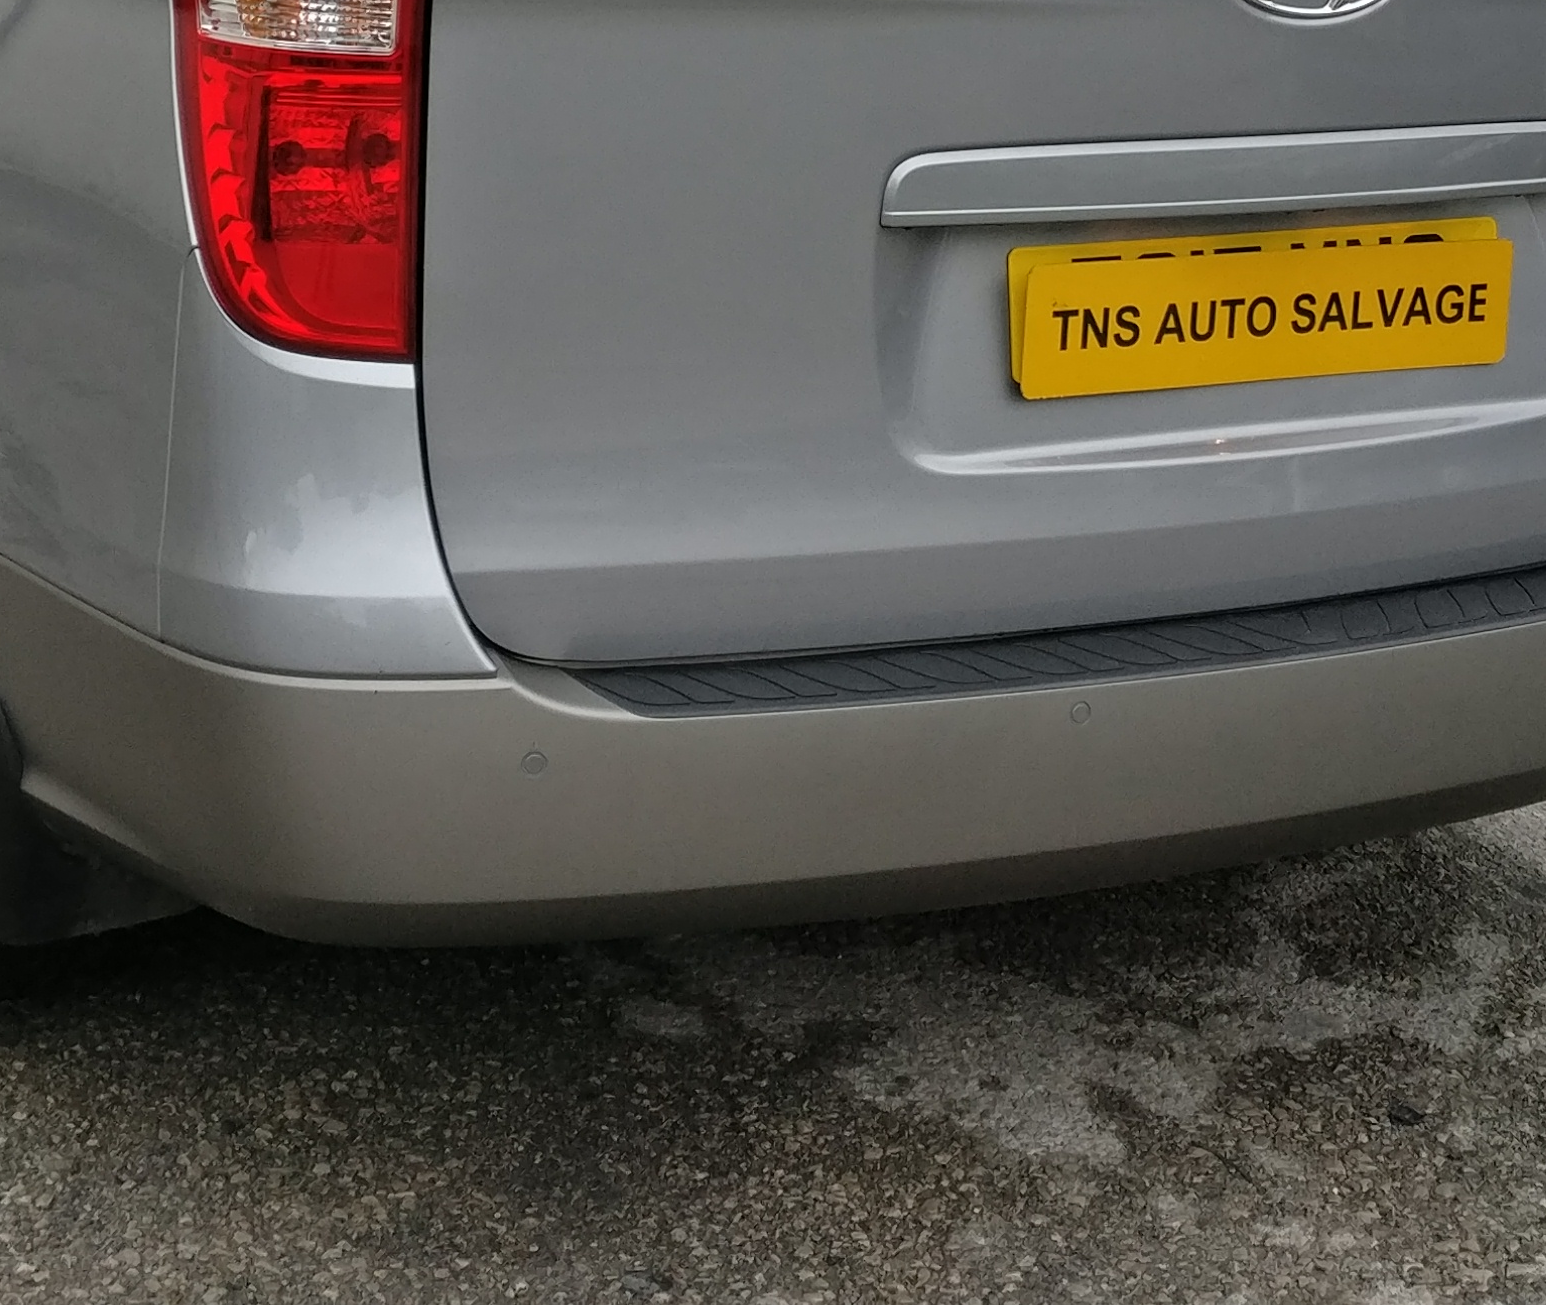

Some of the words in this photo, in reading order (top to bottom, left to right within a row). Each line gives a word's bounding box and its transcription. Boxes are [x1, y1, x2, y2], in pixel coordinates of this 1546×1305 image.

[1052, 304, 1141, 352] TNS
[1154, 295, 1277, 345] AUTO
[1290, 282, 1489, 334] SALVAGE
